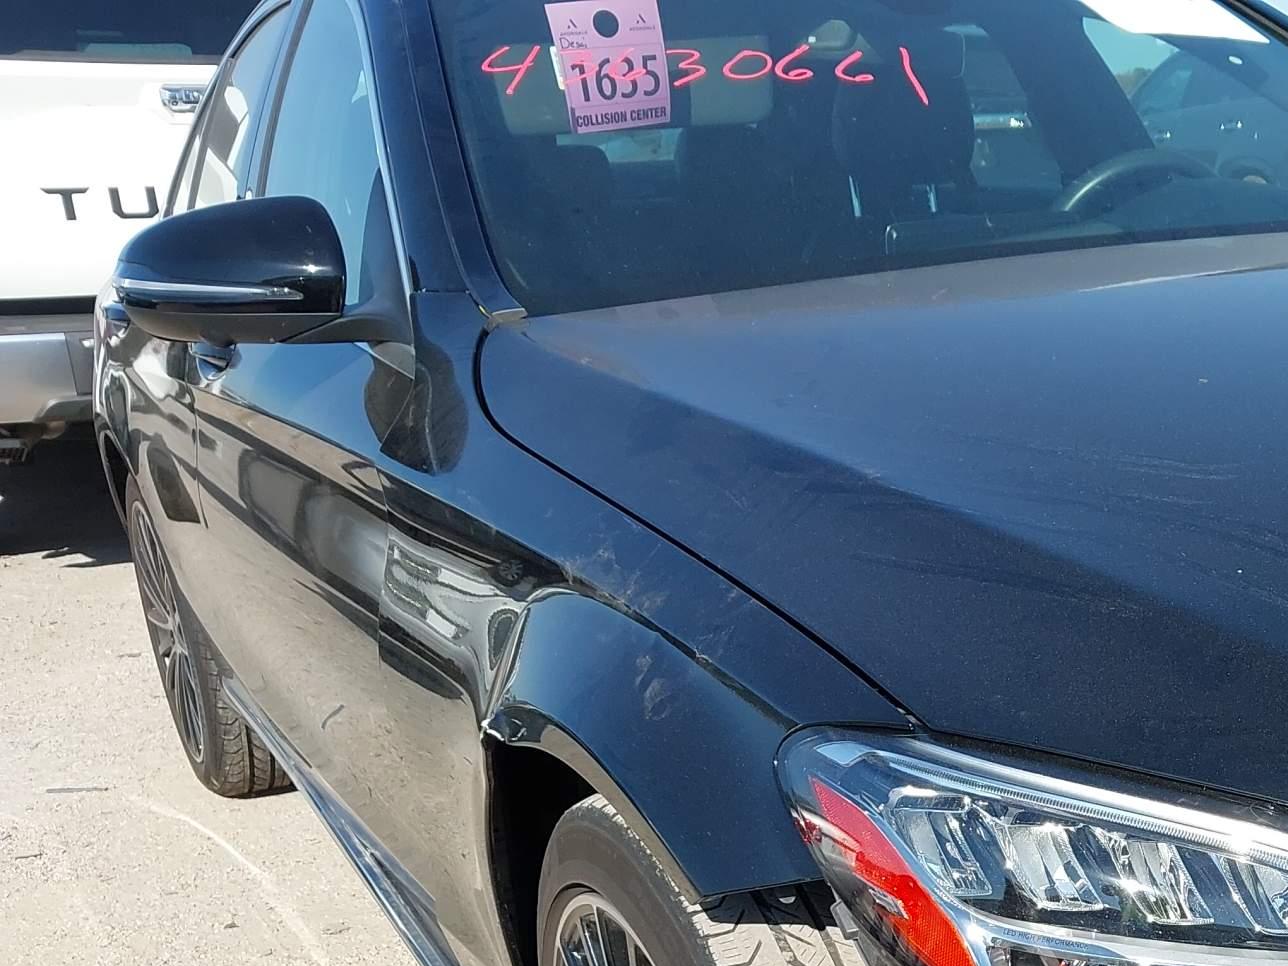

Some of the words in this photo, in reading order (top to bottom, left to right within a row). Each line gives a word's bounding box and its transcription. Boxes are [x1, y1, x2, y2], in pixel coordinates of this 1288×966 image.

[570, 54, 660, 102] 1635
[576, 110, 627, 128] COLLISION
[630, 106, 667, 121] CENTER
